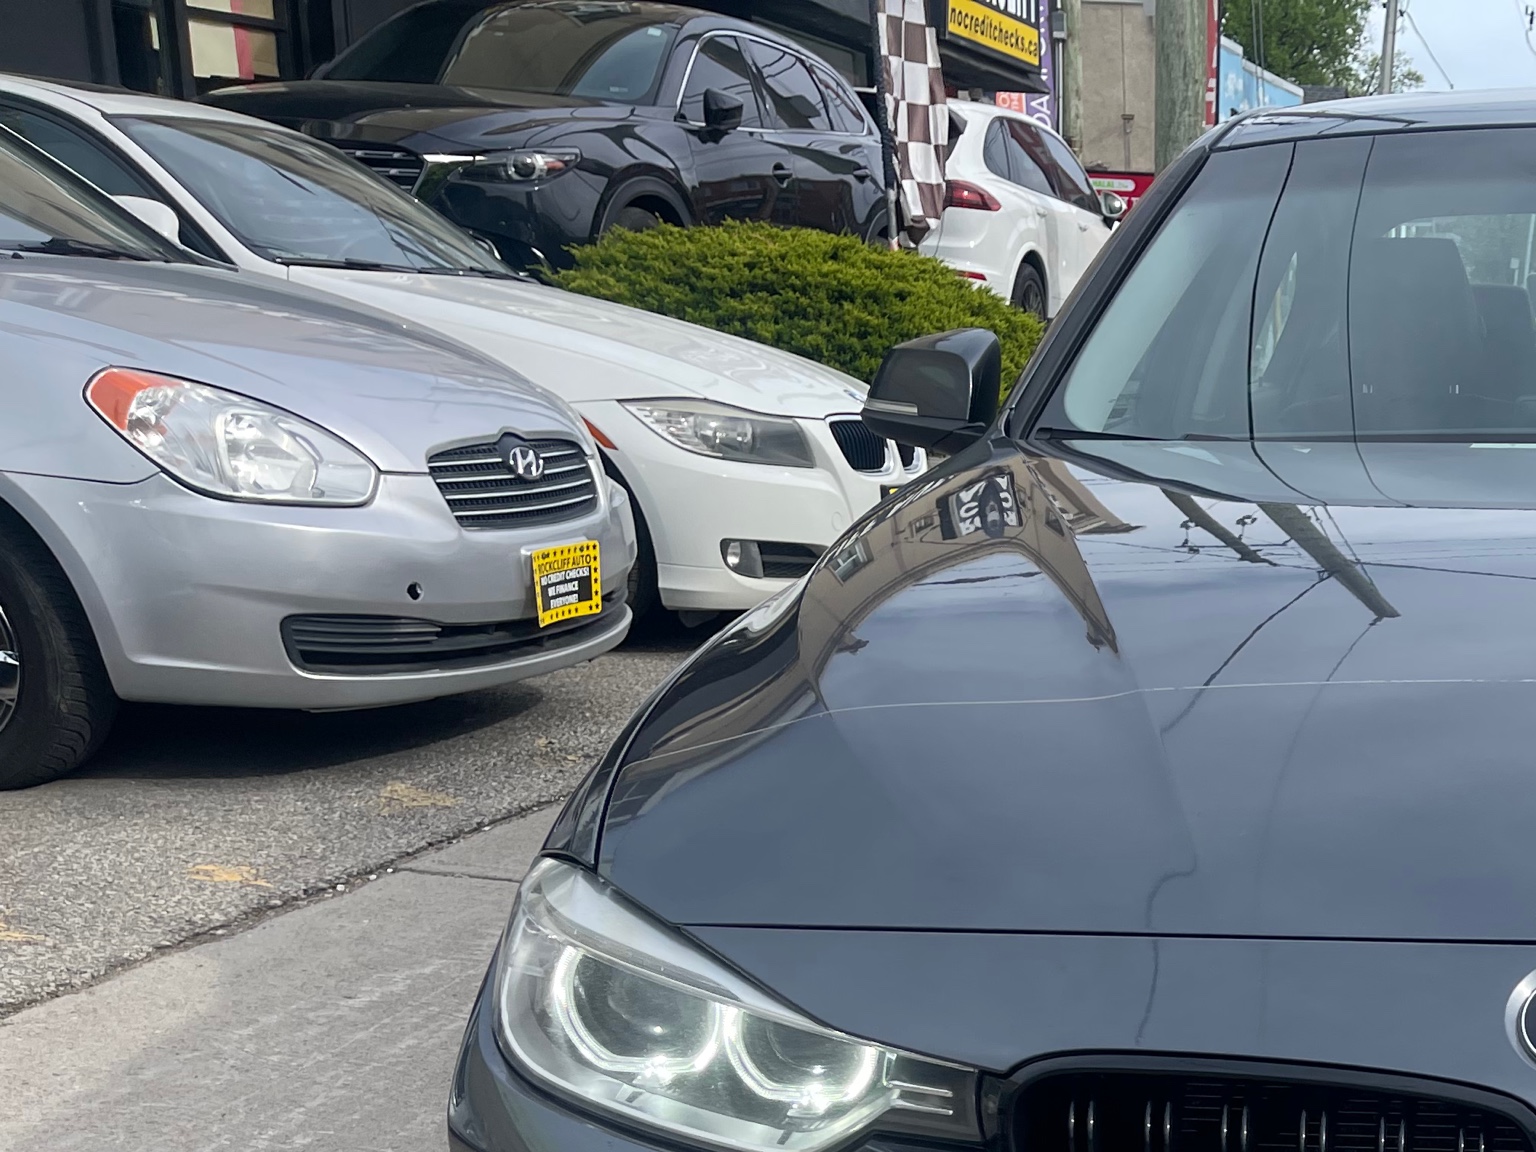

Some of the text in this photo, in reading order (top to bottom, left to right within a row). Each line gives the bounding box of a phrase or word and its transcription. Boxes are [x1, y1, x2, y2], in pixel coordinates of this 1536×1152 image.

[949, 6, 1038, 58] nocreditchecks.ca
[572, 554, 592, 567] AUTO
[548, 571, 565, 584] CREDIT
[566, 566, 590, 580] CHECKS!
[556, 581, 579, 595] FINANCE
